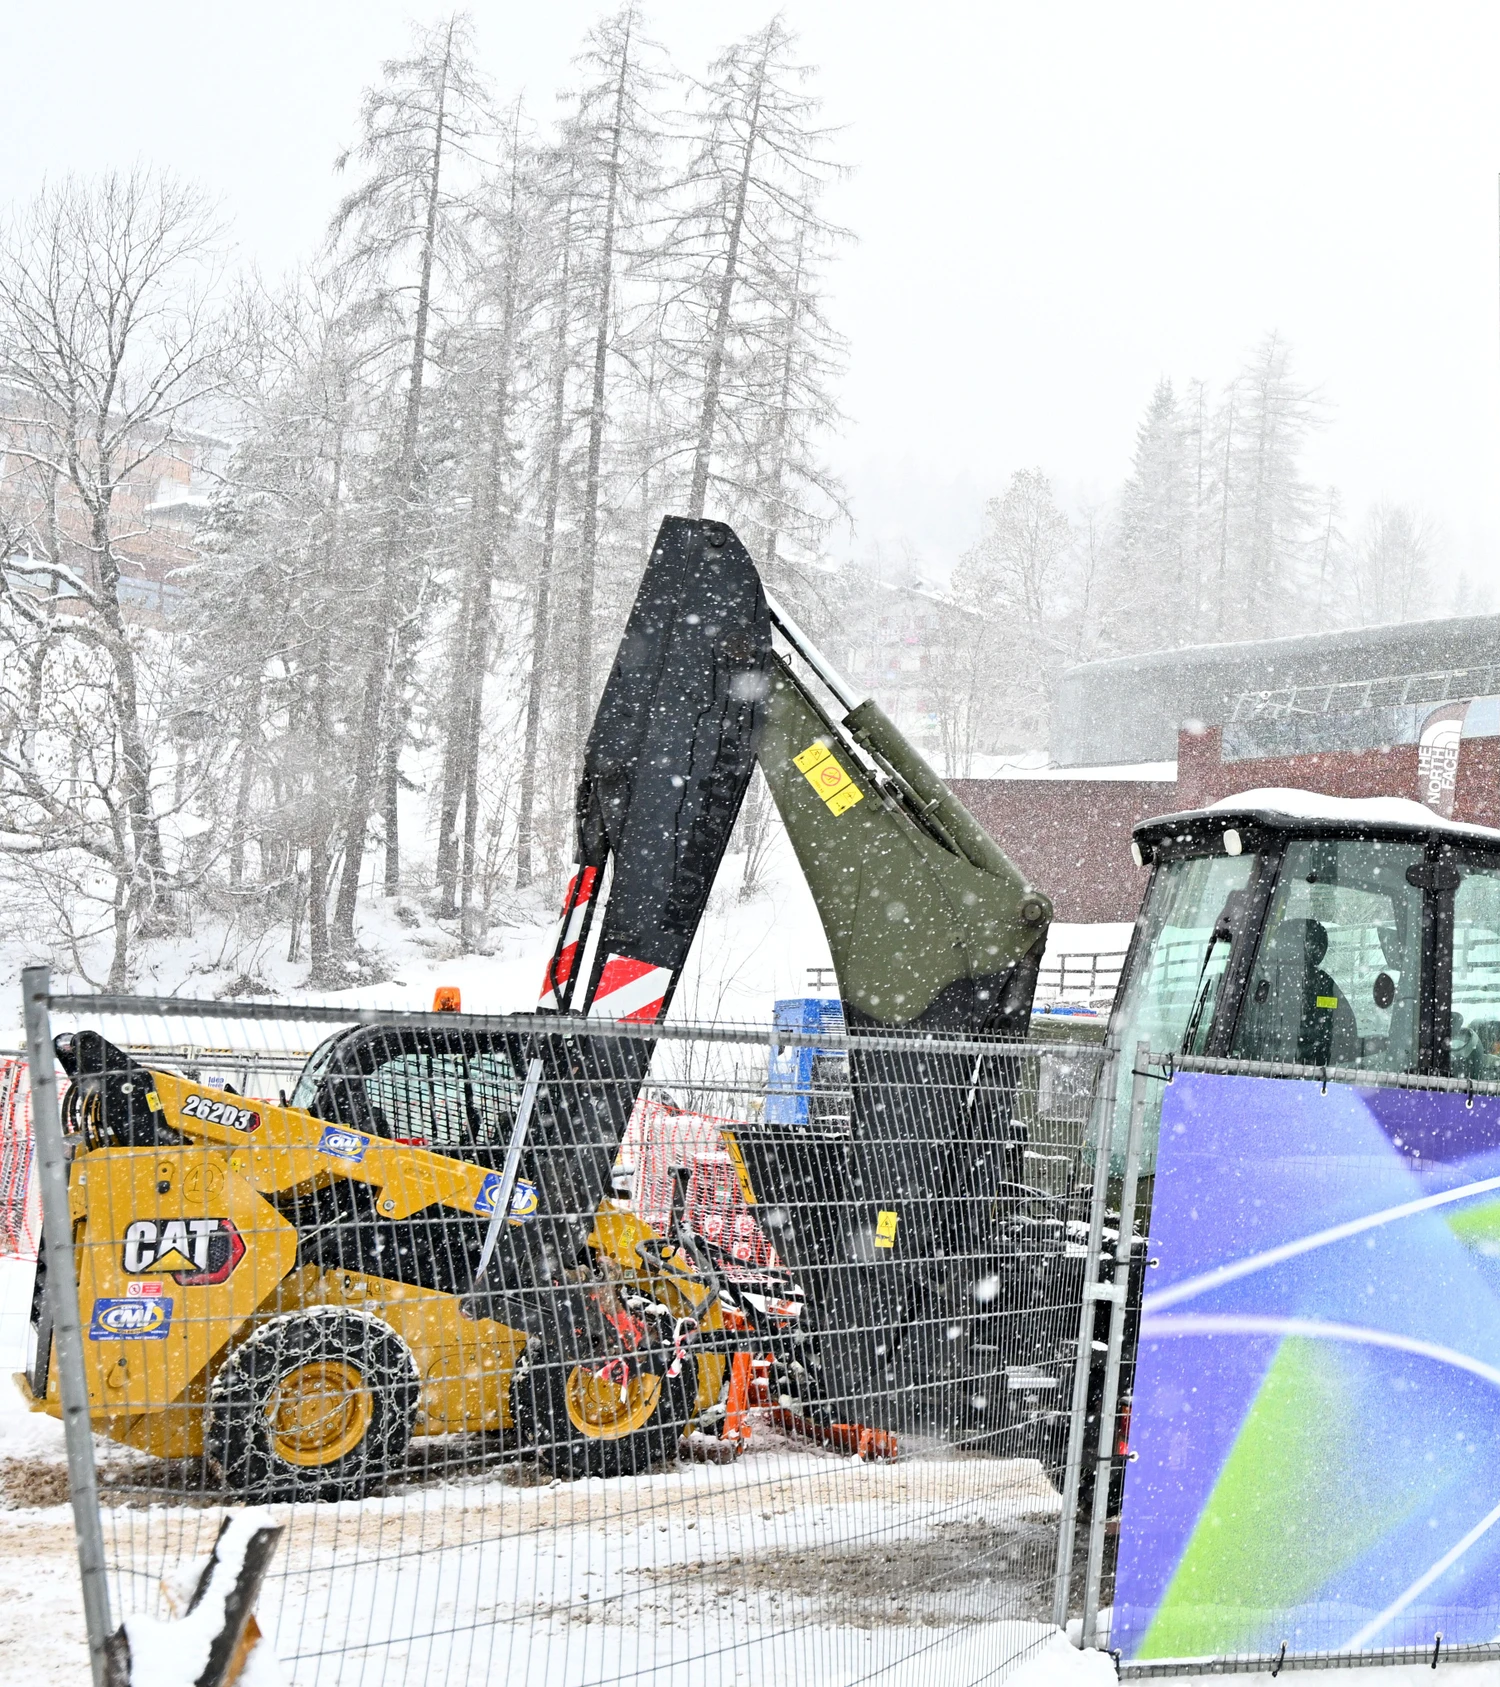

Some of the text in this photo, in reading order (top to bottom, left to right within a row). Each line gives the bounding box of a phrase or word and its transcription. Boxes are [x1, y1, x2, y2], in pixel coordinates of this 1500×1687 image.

[1418, 746, 1432, 775] THE
[1428, 748, 1445, 804] NORTH
[1442, 749, 1458, 790] FACE
[182, 1095, 251, 1130] 262D3
[188, 1169, 215, 1193] 12
[124, 1219, 218, 1272] CAT
